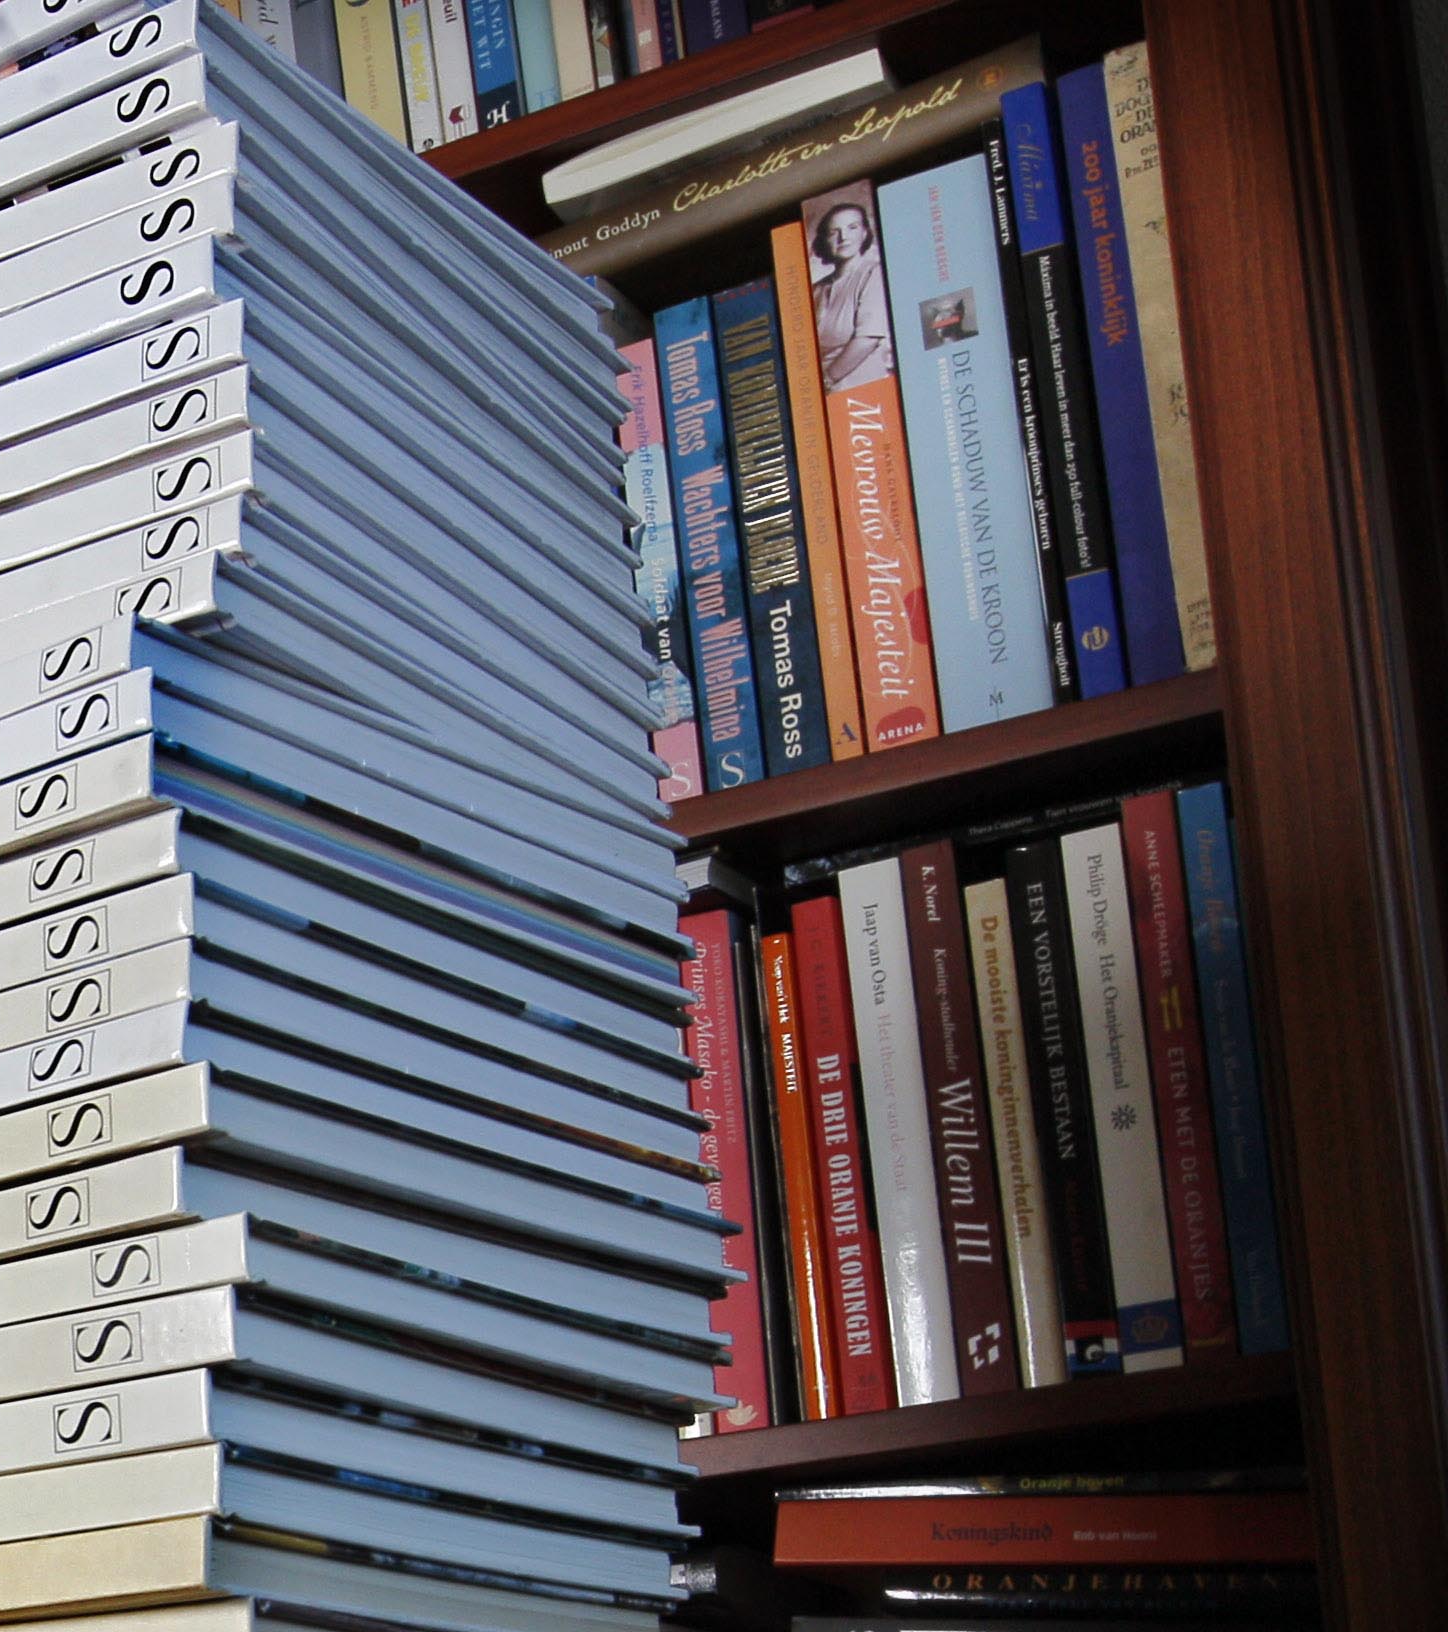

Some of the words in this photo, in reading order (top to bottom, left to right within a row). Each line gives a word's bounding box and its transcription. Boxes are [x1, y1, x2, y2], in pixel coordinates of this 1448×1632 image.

[109, 14, 161, 59] S
[596, 210, 661, 241] Goddyn
[672, 151, 794, 213] Charlotte
[800, 140, 835, 161] en
[838, 78, 963, 144] Leopold
[1082, 141, 1101, 183] 200
[1084, 185, 1110, 230] jaar
[1097, 233, 1129, 347] koninklijk
[666, 331, 708, 404] Tomas
[952, 349, 973, 380] DE
[673, 399, 716, 456] Ross
[956, 384, 989, 493] SCHADUW
[847, 397, 887, 541] Mevrouw
[682, 465, 729, 570] Wachters
[970, 497, 994, 544] VAN
[976, 548, 998, 580] DE
[694, 570, 726, 619] voor
[769, 600, 794, 688] Tomas
[861, 550, 915, 700] Majesteit
[981, 583, 1009, 666] KROON
[700, 618, 751, 742] Wilhelmina
[780, 693, 802, 759] Ross
[877, 722, 924, 742] ARENA
[721, 752, 744, 789] S
[922, 865, 935, 883] K.
[863, 903, 878, 938] Jaap
[924, 887, 942, 924] Norel
[1027, 882, 1047, 926] EEN
[870, 940, 881, 966] van
[873, 969, 887, 1005] Osta
[1033, 929, 1063, 1057] VORSTELIJK
[817, 1054, 840, 1083] DE
[823, 1093, 848, 1146] DRIE
[1049, 1065, 1076, 1161] BESTAAN
[939, 1079, 980, 1207] Willem
[828, 1157, 858, 1237] ORANJE
[954, 1220, 992, 1265] III
[837, 1243, 872, 1357] KONINGEN
[57, 1401, 112, 1444] S
